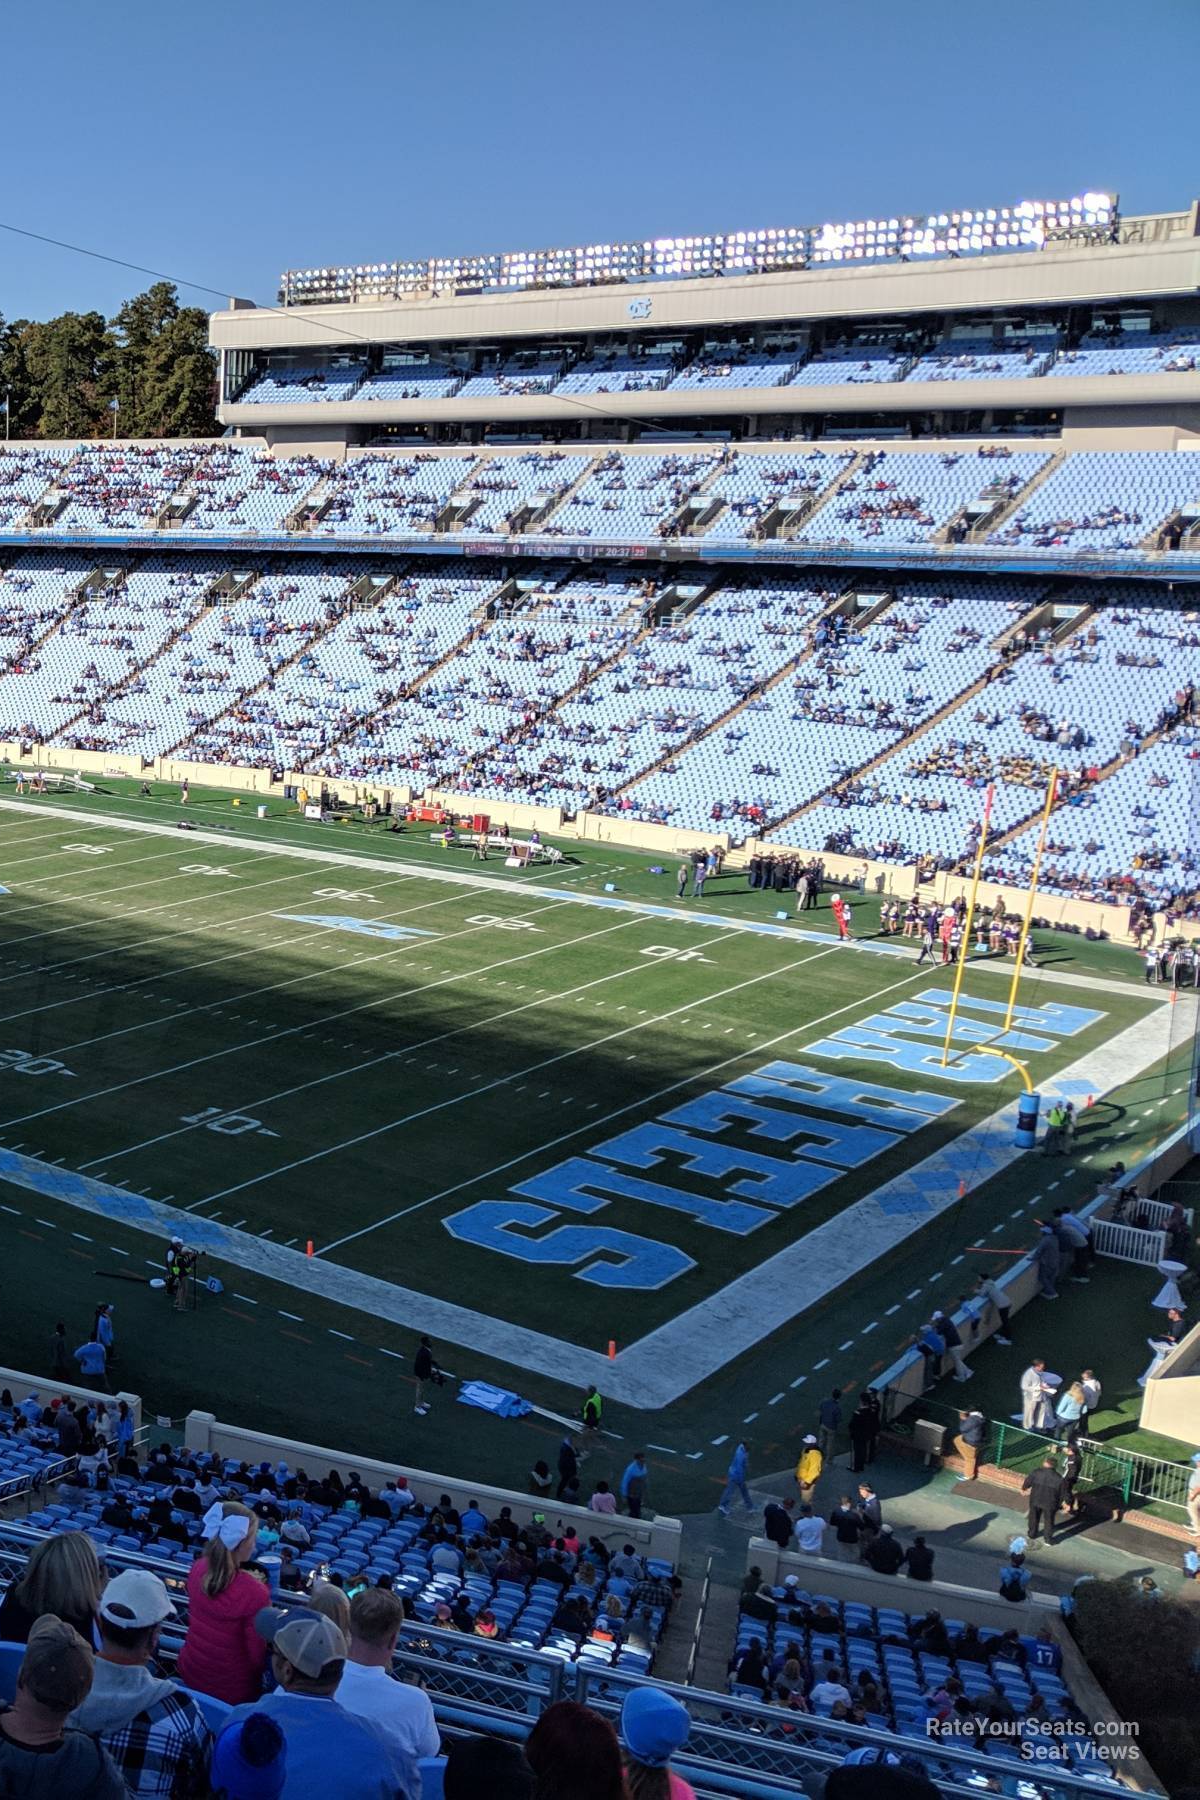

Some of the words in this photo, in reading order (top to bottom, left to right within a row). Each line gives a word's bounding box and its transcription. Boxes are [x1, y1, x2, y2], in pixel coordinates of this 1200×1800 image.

[800, 988, 1109, 1082] TAR
[180, 1107, 262, 1134] 10
[441, 1060, 966, 1291] HEELS
[1036, 1650, 1054, 1666] 17
